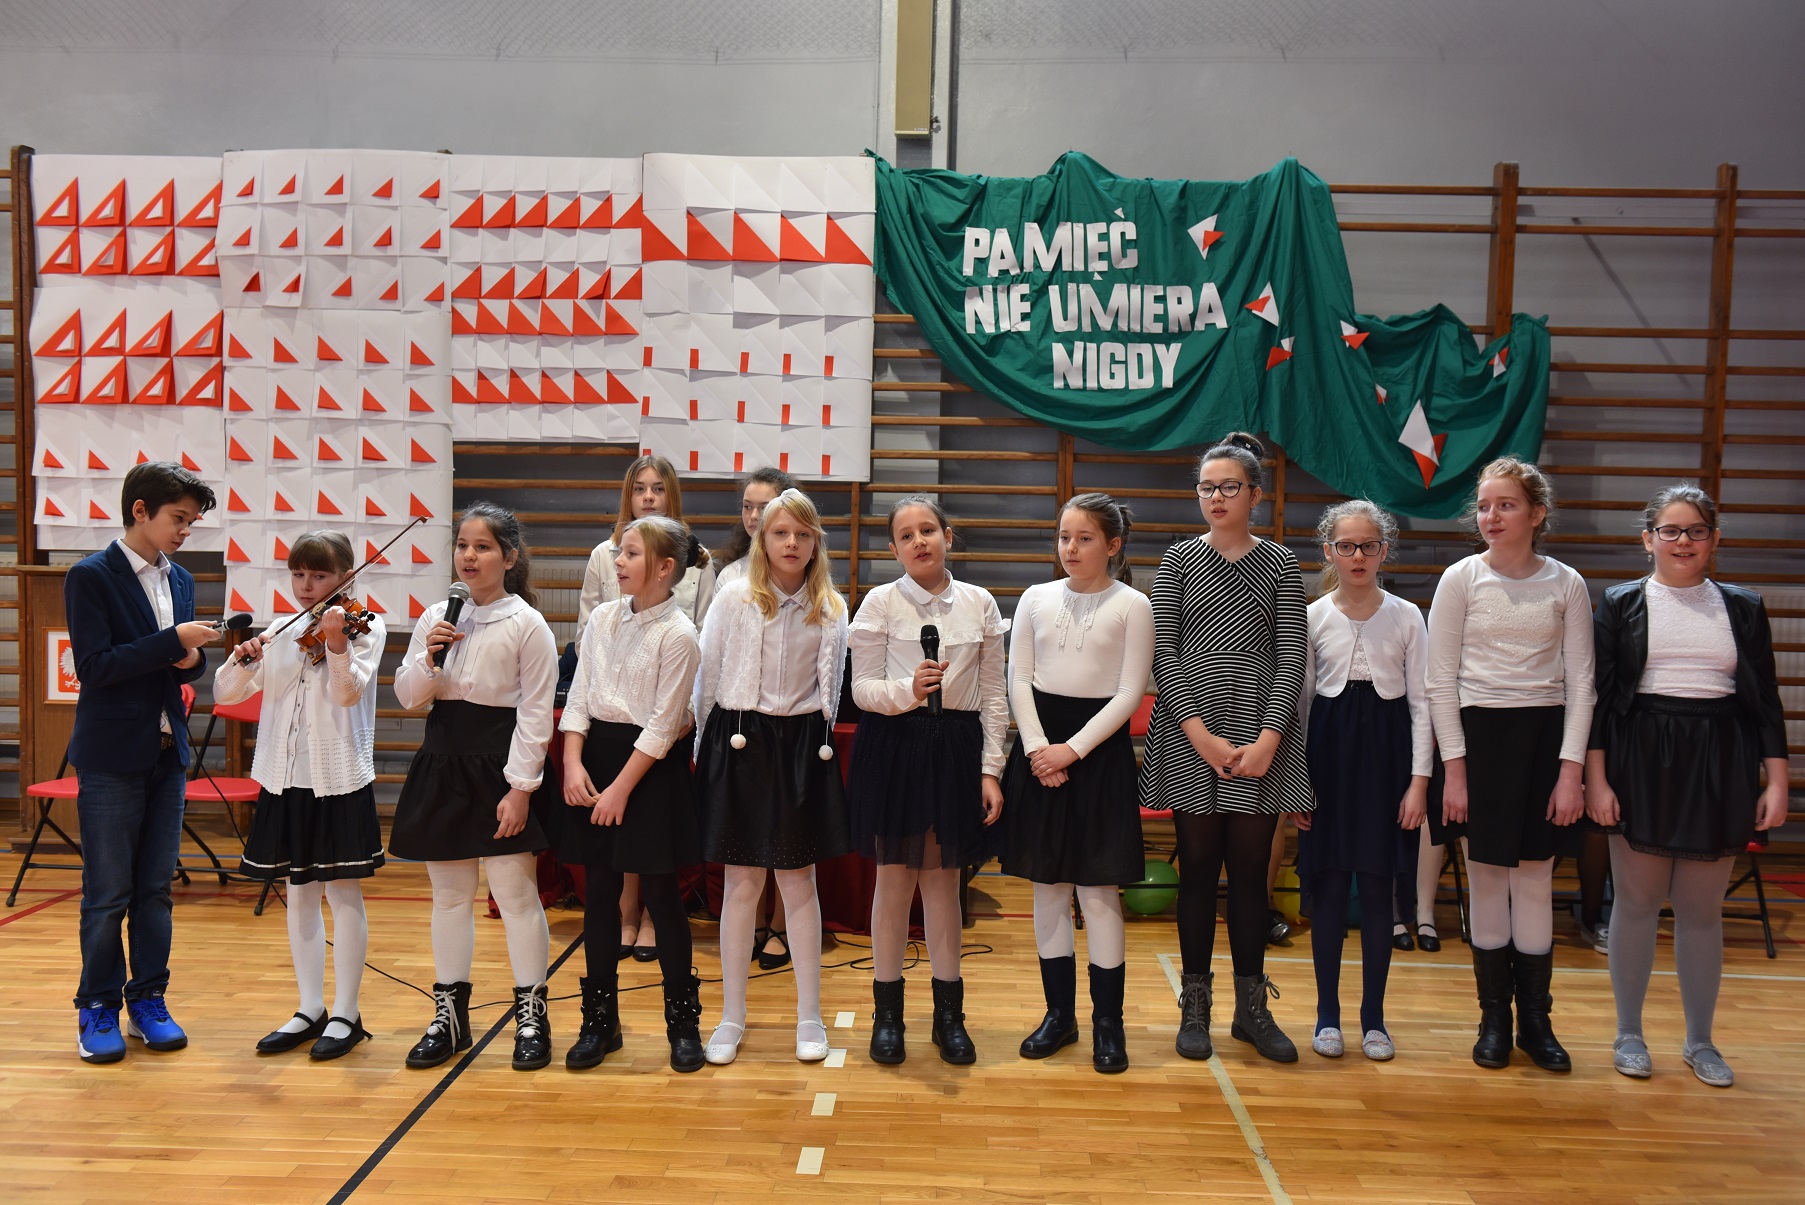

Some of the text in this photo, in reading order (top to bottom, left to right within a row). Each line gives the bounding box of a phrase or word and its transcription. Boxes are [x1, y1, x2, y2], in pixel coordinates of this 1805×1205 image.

[963, 207, 1138, 280] PAMIĘĆ
[964, 282, 1228, 334] NIE UMIERA
[1052, 341, 1182, 390] NIGDY
